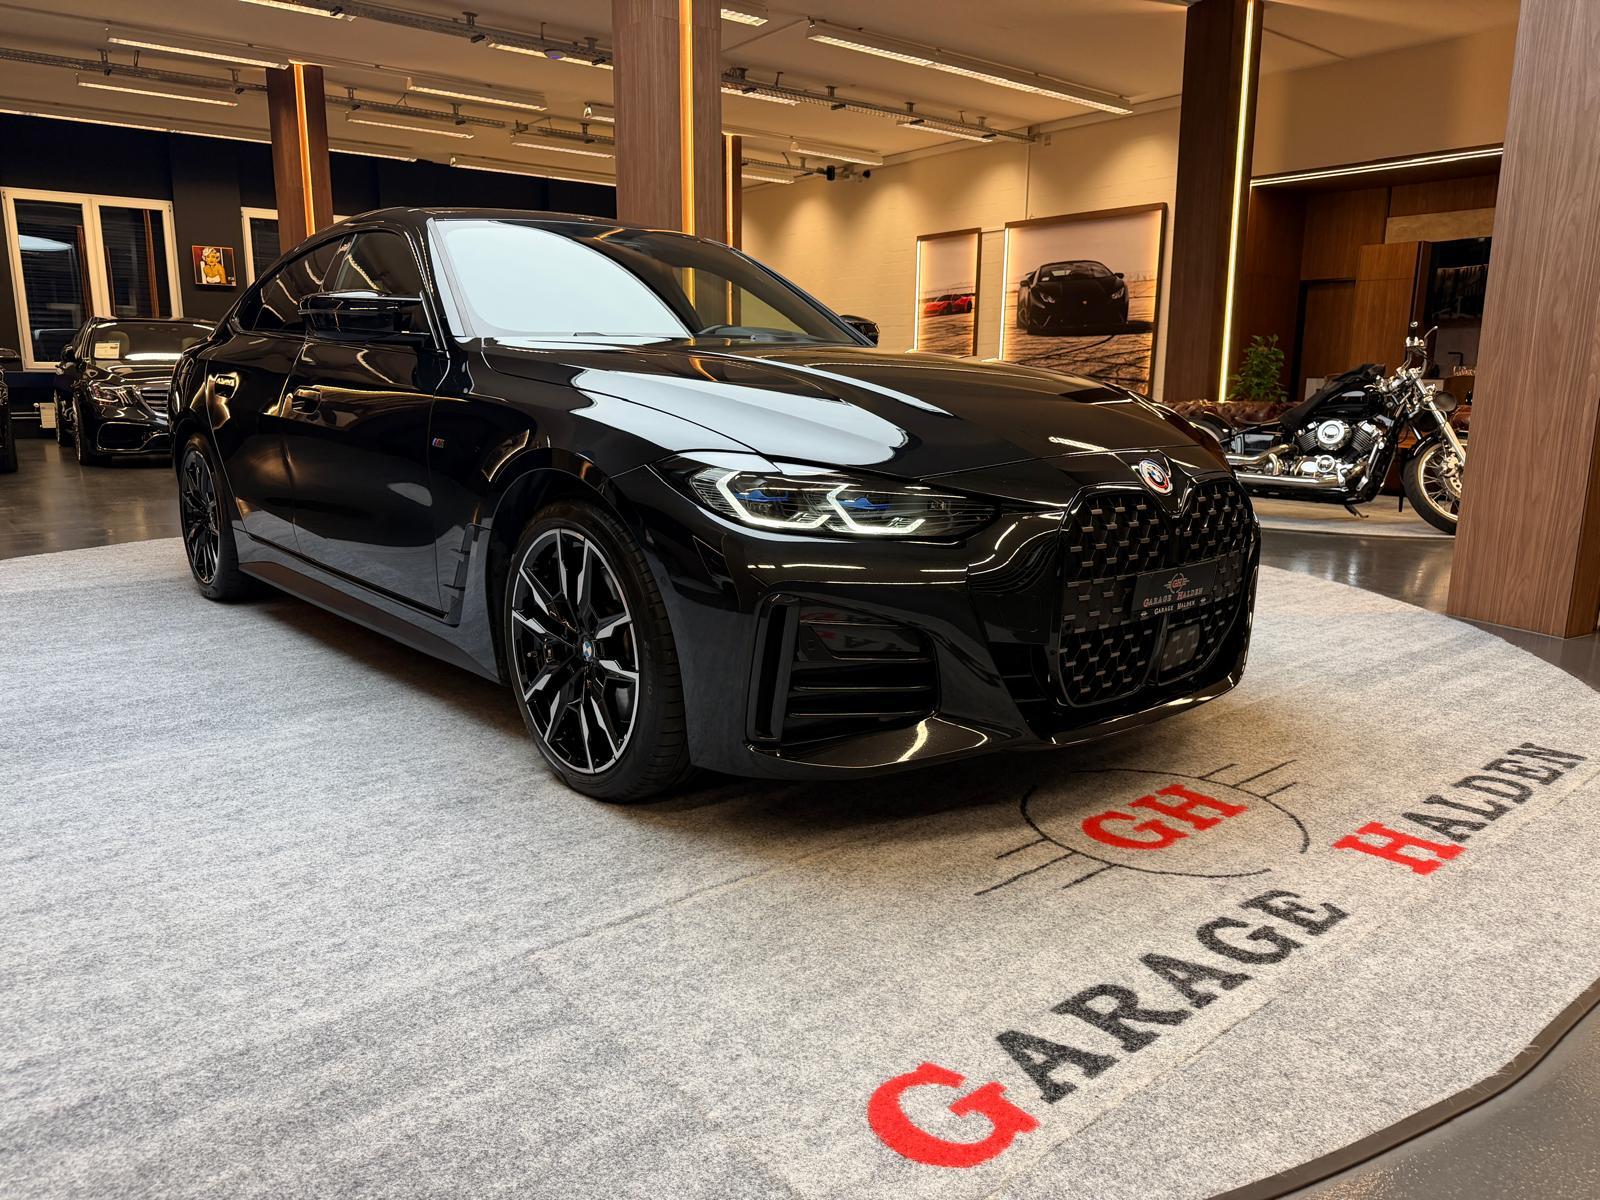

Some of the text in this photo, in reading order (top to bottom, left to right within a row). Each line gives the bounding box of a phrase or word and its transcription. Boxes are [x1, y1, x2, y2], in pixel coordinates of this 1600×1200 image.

[1143, 588, 1203, 608] GARAGE HALDEN
[1081, 784, 1248, 851] GH
[867, 742, 1588, 1168] GARAGE HALDEN
